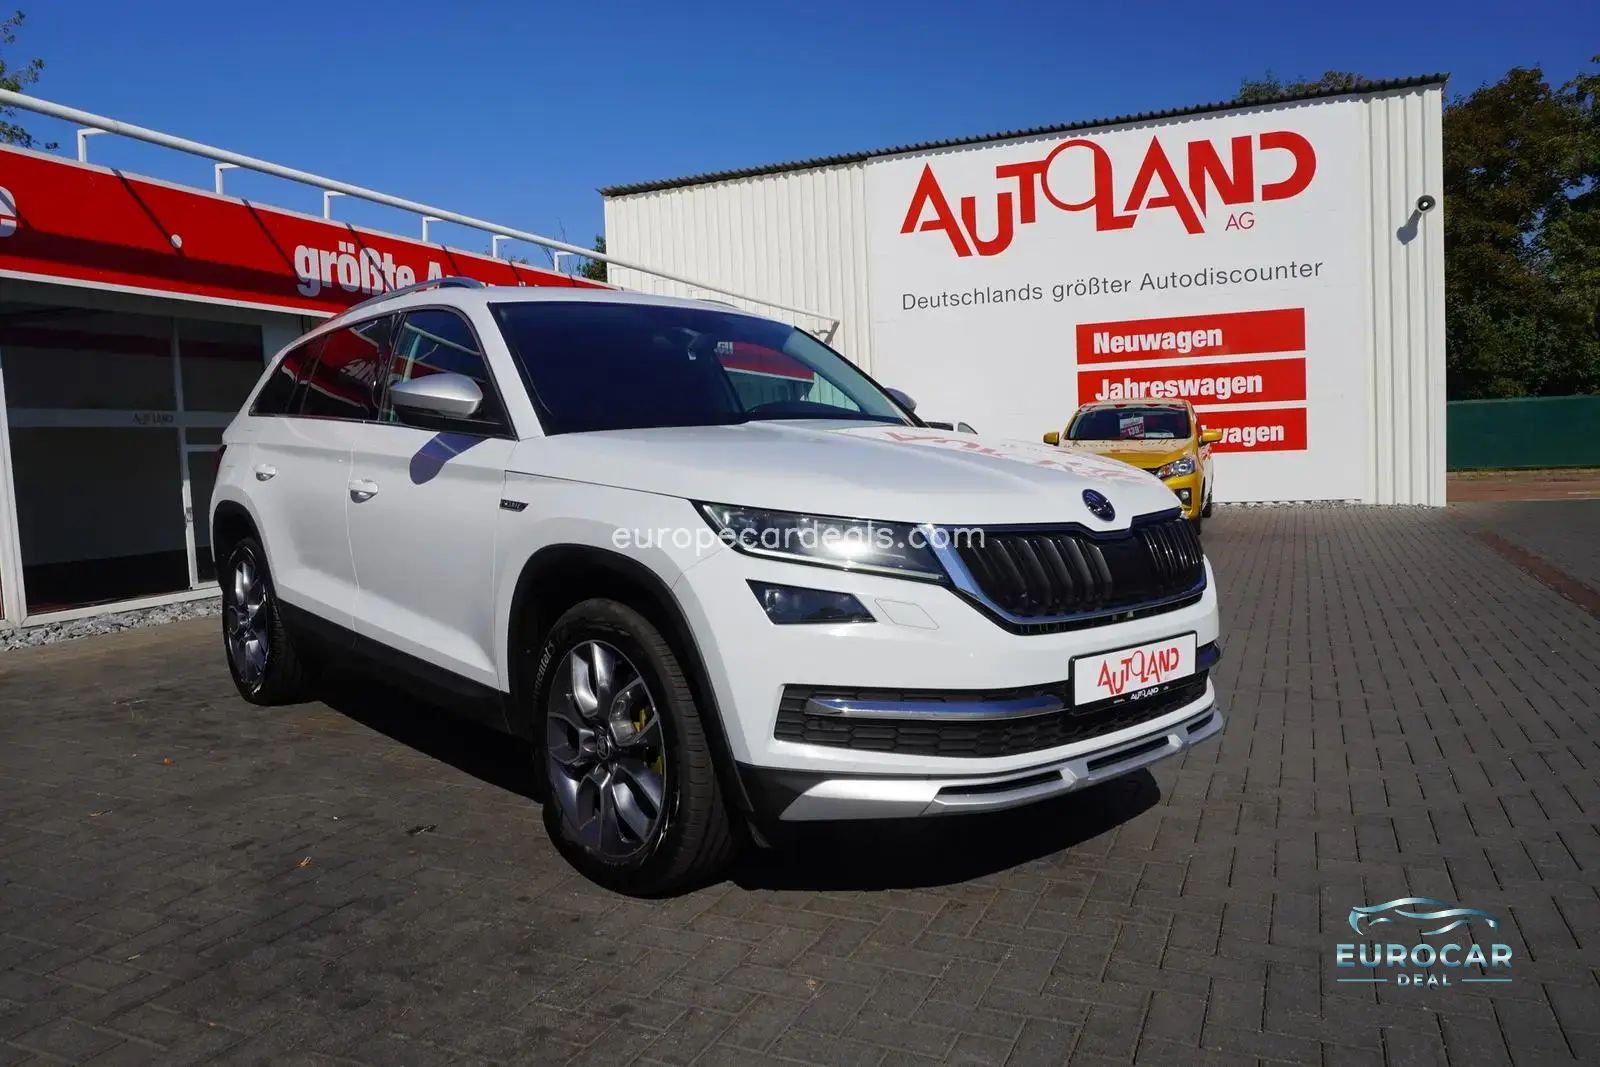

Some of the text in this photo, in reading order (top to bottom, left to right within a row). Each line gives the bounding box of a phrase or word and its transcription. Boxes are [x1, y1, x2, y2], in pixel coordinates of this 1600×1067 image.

[900, 131, 1317, 257] AUTOLAND
[1224, 211, 1255, 232] AG
[294, 240, 416, 298] größte
[901, 260, 1324, 312] Deutschlands größter Autodiscounter
[1092, 327, 1223, 355] Neuwagen
[1094, 374, 1263, 401] Jahreswagen
[1096, 647, 1180, 695] AUTOLAND
